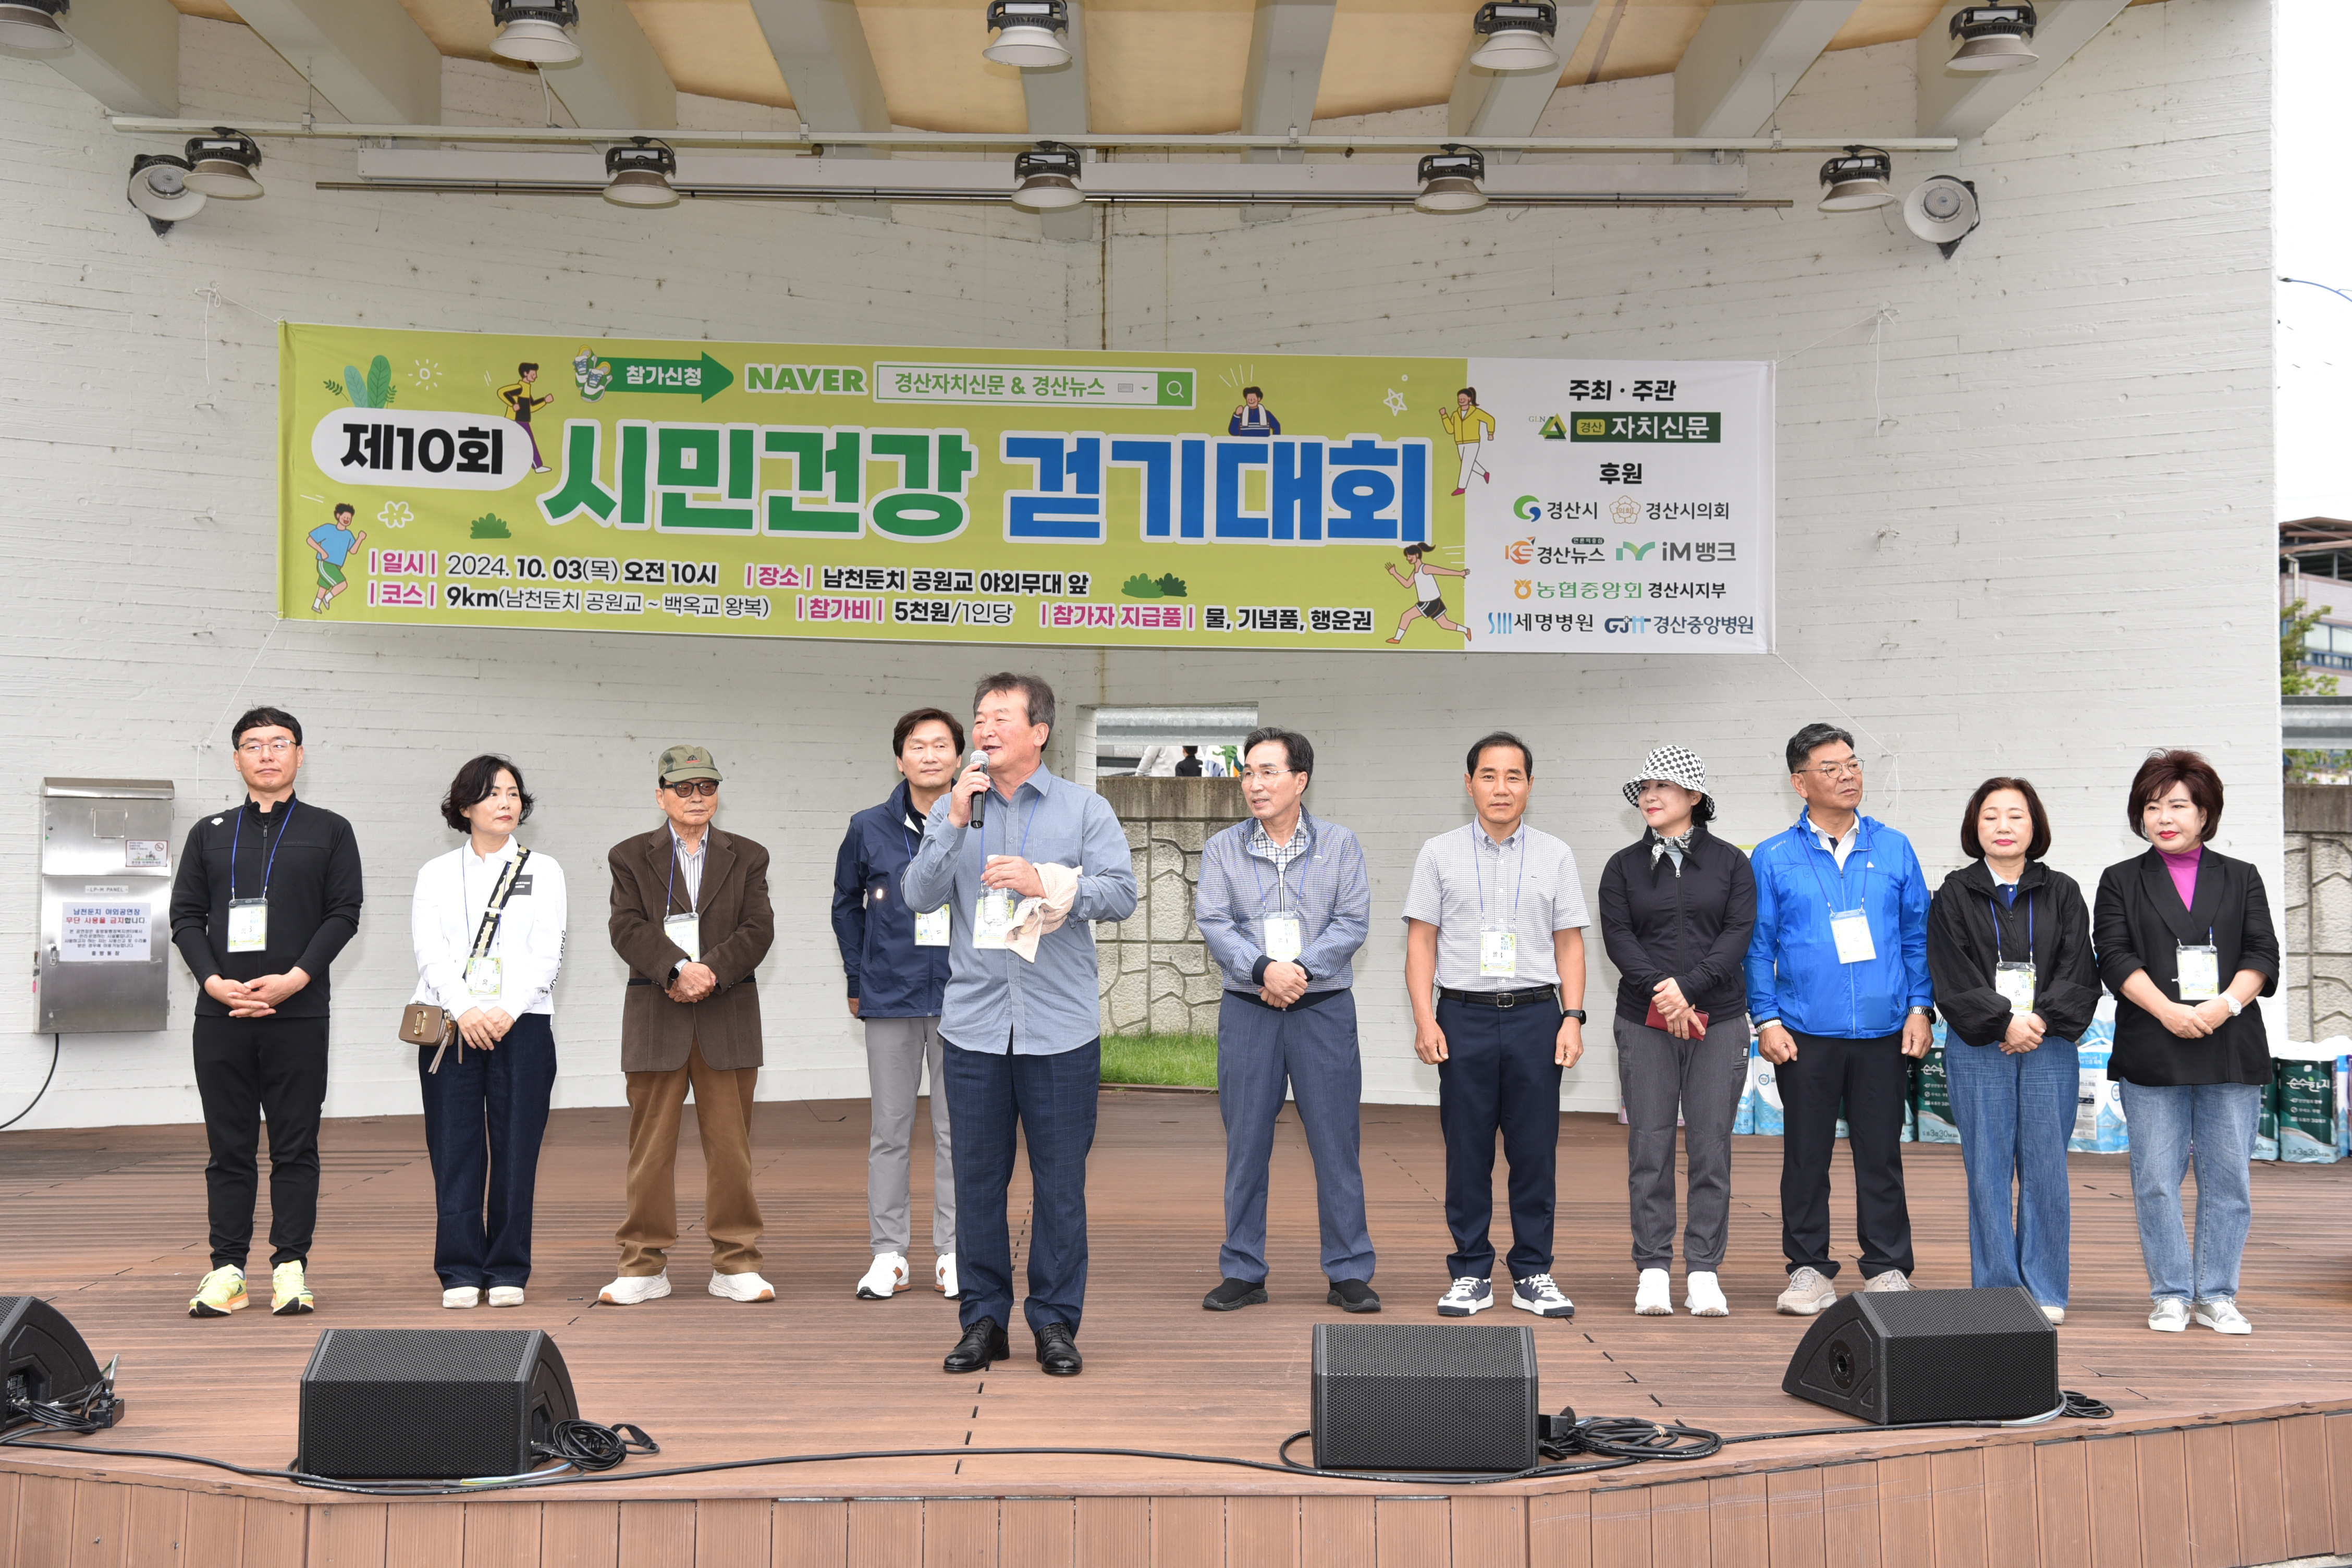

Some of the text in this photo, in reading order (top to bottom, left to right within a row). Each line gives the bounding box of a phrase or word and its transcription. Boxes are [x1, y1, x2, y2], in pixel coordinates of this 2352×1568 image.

[626, 364, 702, 387] 참가신청
[748, 368, 864, 392] NAVER
[895, 373, 1105, 397] 경산자치신문 & 경산뉴스
[1569, 379, 1612, 401] 주최
[1632, 380, 1676, 402] 주관
[1580, 416, 1709, 439] 경산 자치신문
[340, 423, 503, 475] 제10회
[544, 424, 1426, 542] 시민건강 걷기대회
[1599, 463, 1643, 485] 후원
[1547, 501, 1598, 520] 경산시
[1646, 501, 1729, 520] 경산시의회
[1537, 547, 1606, 564] 경산뉴스
[1662, 542, 1736, 562] iM 뱅크
[447, 555, 510, 575] 2024.
[517, 558, 546, 579] 10.
[553, 559, 618, 581] 03(목)
[624, 561, 665, 583] 오전
[672, 563, 716, 584] 10시
[824, 569, 905, 592] 남천둔치
[912, 571, 974, 593] 공원교
[979, 572, 1062, 595] 야외무대
[1069, 574, 1088, 595] 앞
[1536, 581, 1726, 599] 농협중앙회 경산시지부
[447, 586, 580, 611] 9km(남천둔치
[586, 591, 642, 614] 공원교
[664, 593, 719, 616] 백옥교
[725, 595, 769, 618] 왕복)
[895, 602, 1013, 624] 5천원/1인당
[1206, 608, 1233, 630] 물,
[1238, 608, 1305, 631] 기념품,
[1311, 610, 1372, 631] 행운권
[1514, 613, 1593, 632] 세명병원
[1653, 616, 1754, 635] 경산중앙병원
